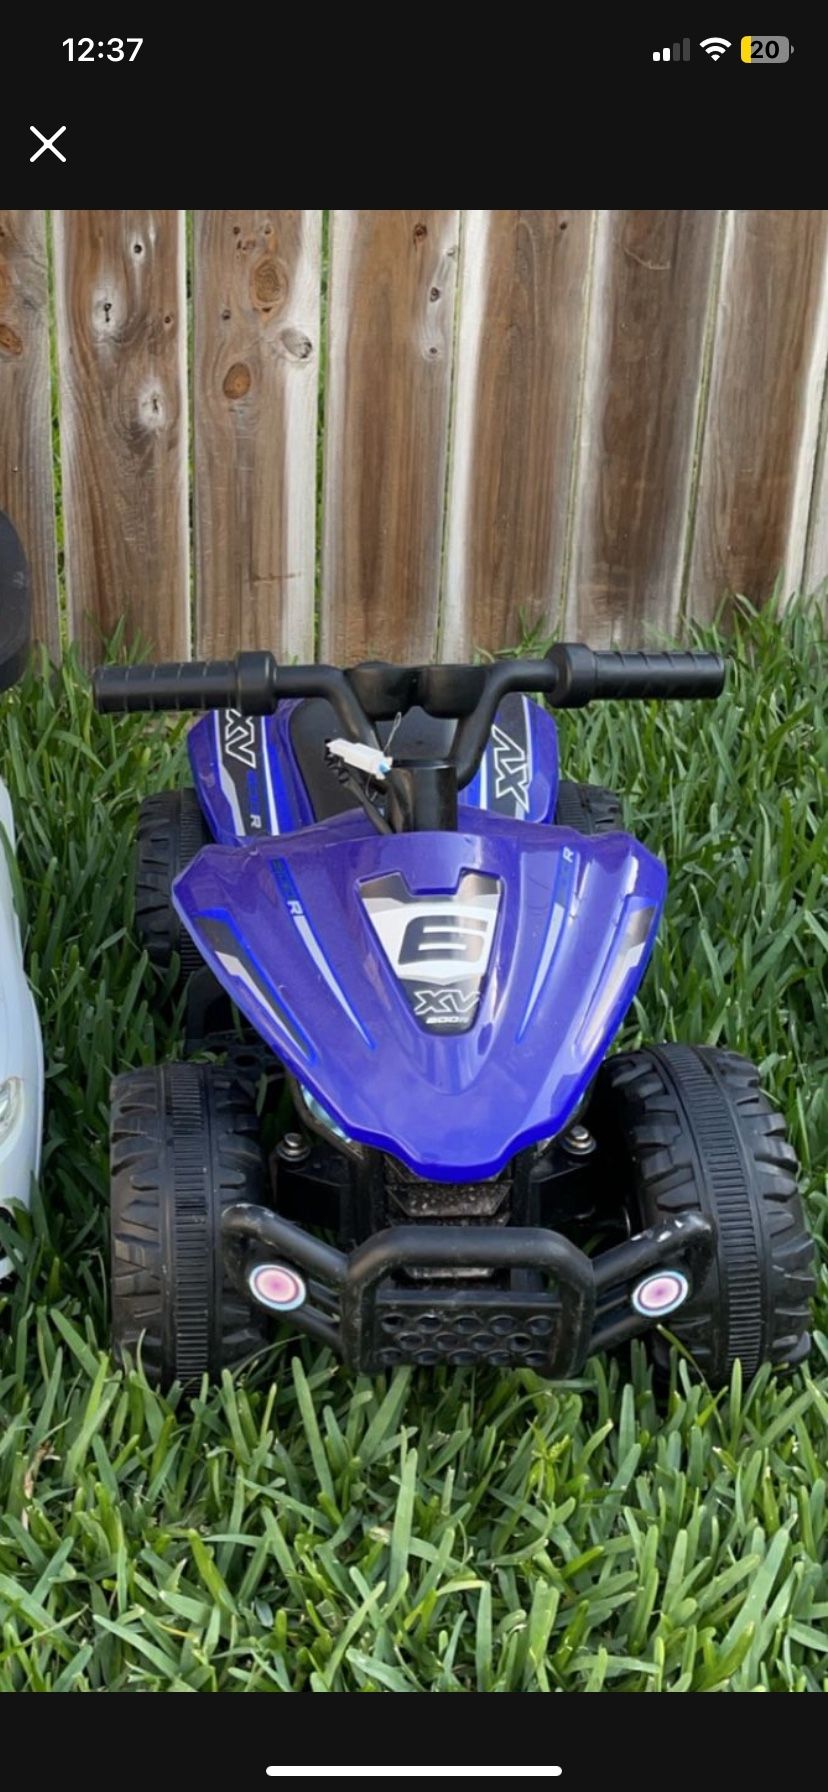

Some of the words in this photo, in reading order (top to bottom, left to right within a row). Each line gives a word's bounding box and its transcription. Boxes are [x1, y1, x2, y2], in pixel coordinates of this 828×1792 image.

[491, 724, 530, 813] XV
[397, 914, 489, 966] 6
[413, 989, 481, 1015] XV
